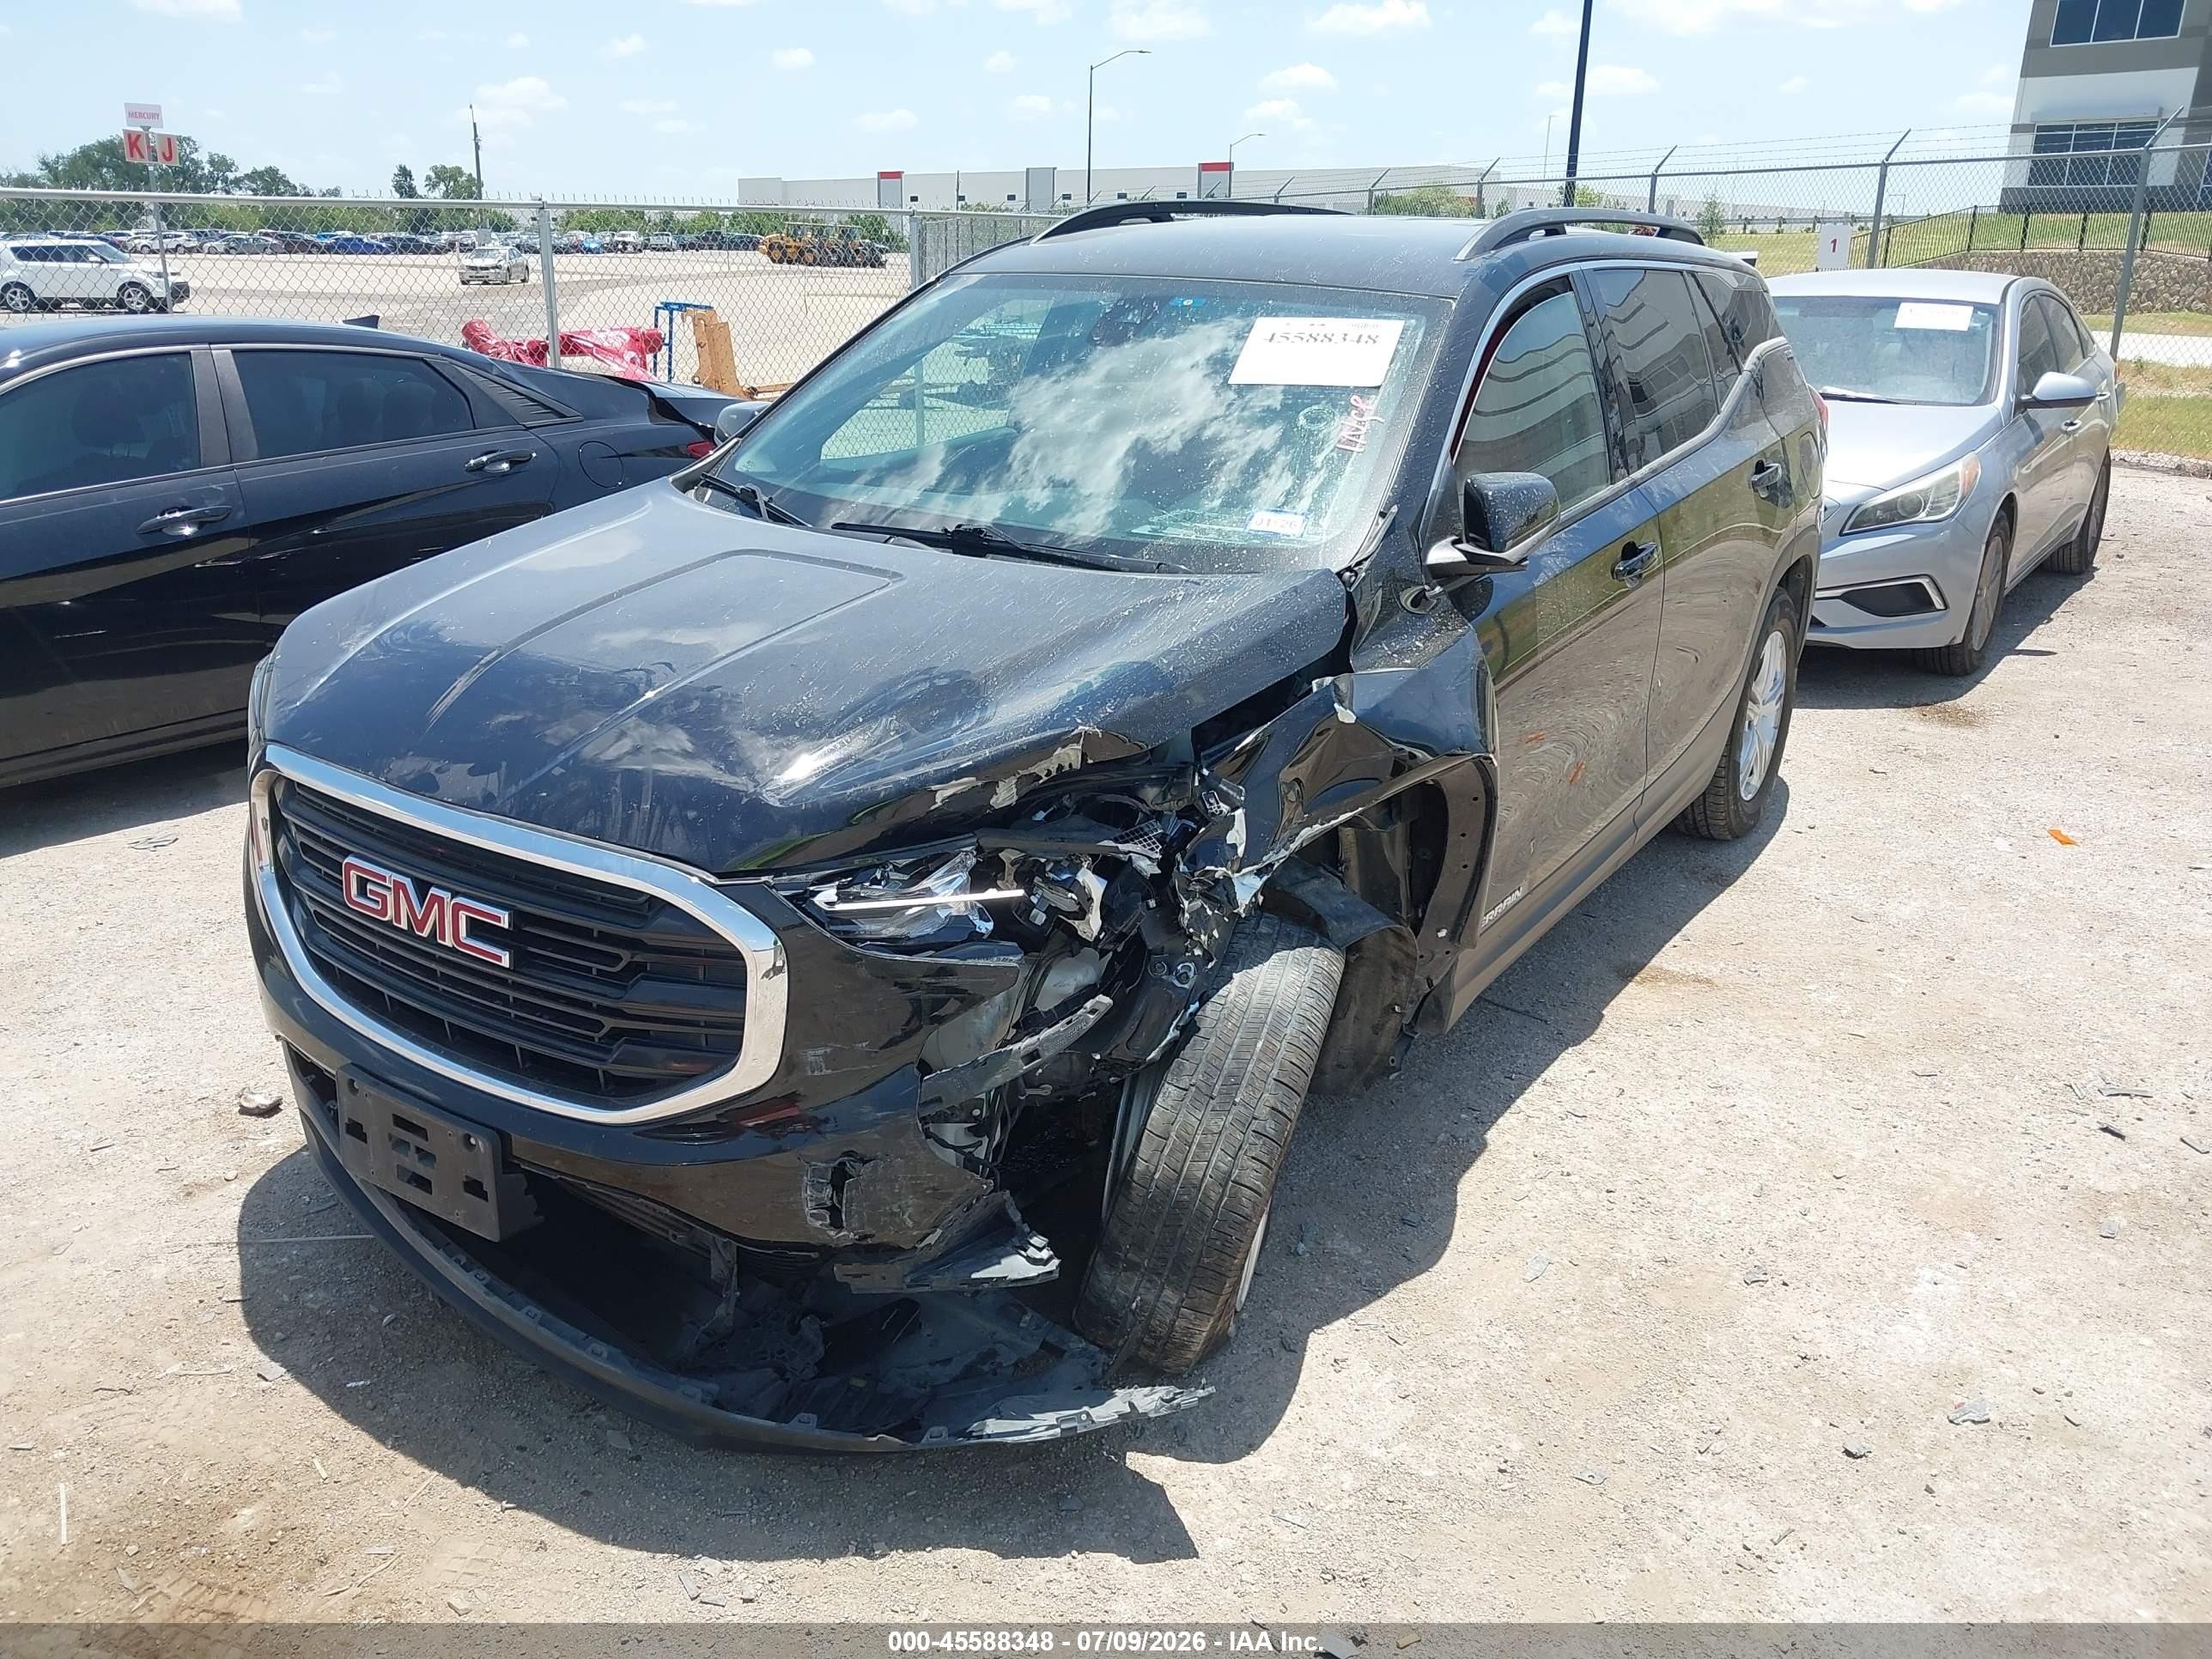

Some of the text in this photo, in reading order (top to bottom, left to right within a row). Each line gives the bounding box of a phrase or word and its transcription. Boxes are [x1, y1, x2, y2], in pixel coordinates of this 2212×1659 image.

[128, 111, 160, 119] MERCURY
[127, 133, 173, 161] K J
[1830, 238, 1838, 253] 1
[1263, 331, 1379, 344] 45588348
[342, 852, 514, 969] GMC
